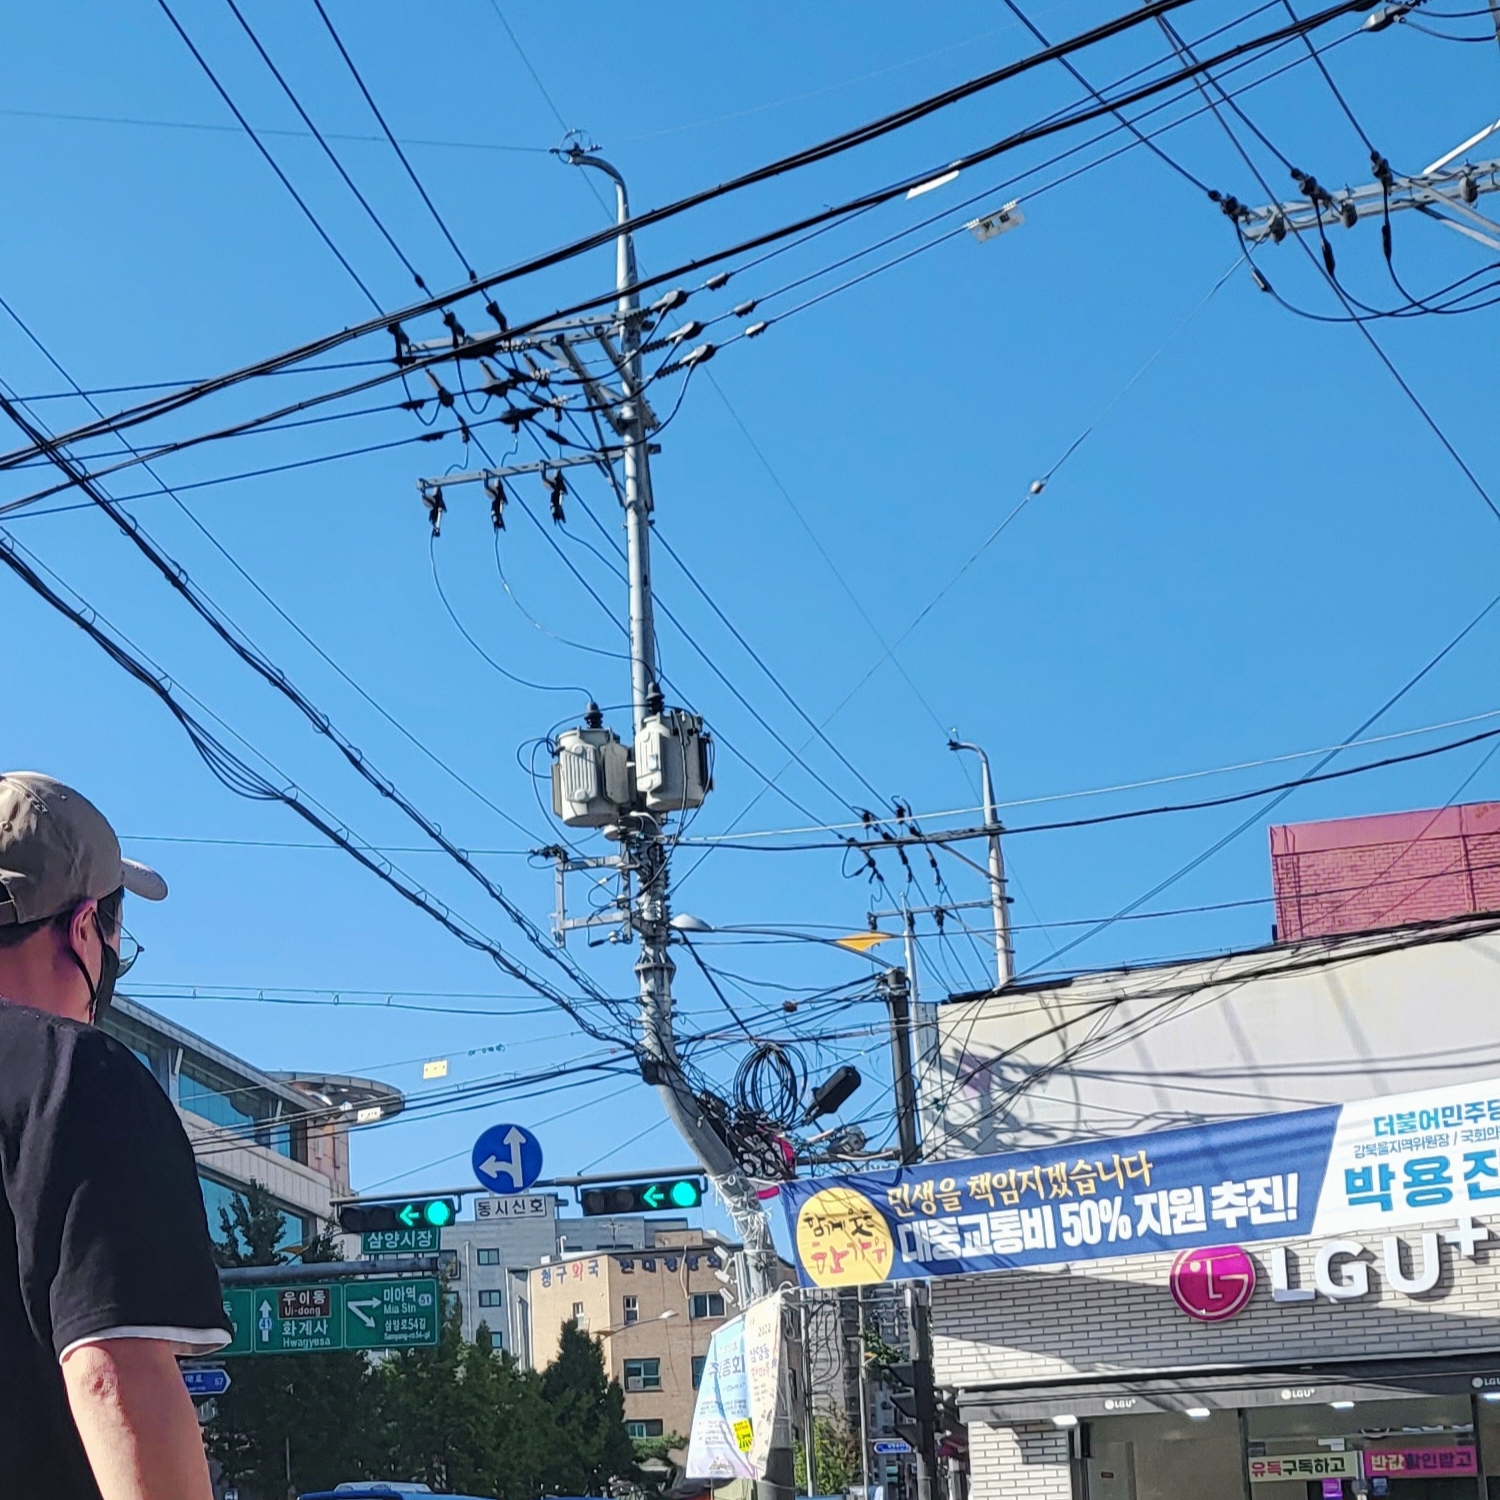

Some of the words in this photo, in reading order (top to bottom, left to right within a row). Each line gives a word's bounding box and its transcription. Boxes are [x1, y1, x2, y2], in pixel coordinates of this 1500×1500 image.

[1460, 1125, 1500, 1143] 국회의
[886, 1177, 962, 1217] 민생을
[967, 1149, 1154, 1208] 책임지겠습니다
[477, 1197, 544, 1218] 동시신호
[897, 1205, 1056, 1264] 대중교통비
[1059, 1195, 1132, 1248] 50%
[1134, 1184, 1208, 1237] 지원
[1210, 1171, 1299, 1230] 추진!
[367, 1232, 432, 1250] 삼양시장
[282, 1290, 327, 1305] 우이동
[383, 1285, 416, 1302] 미아역
[284, 1306, 321, 1318] Ui-dong
[383, 1304, 400, 1315] Mia
[281, 1319, 329, 1336] 화계사
[384, 1318, 426, 1332] 삼양로54길
[282, 1337, 331, 1349] Hwagyesa
[1251, 1458, 1346, 1479] 유독구독하고
